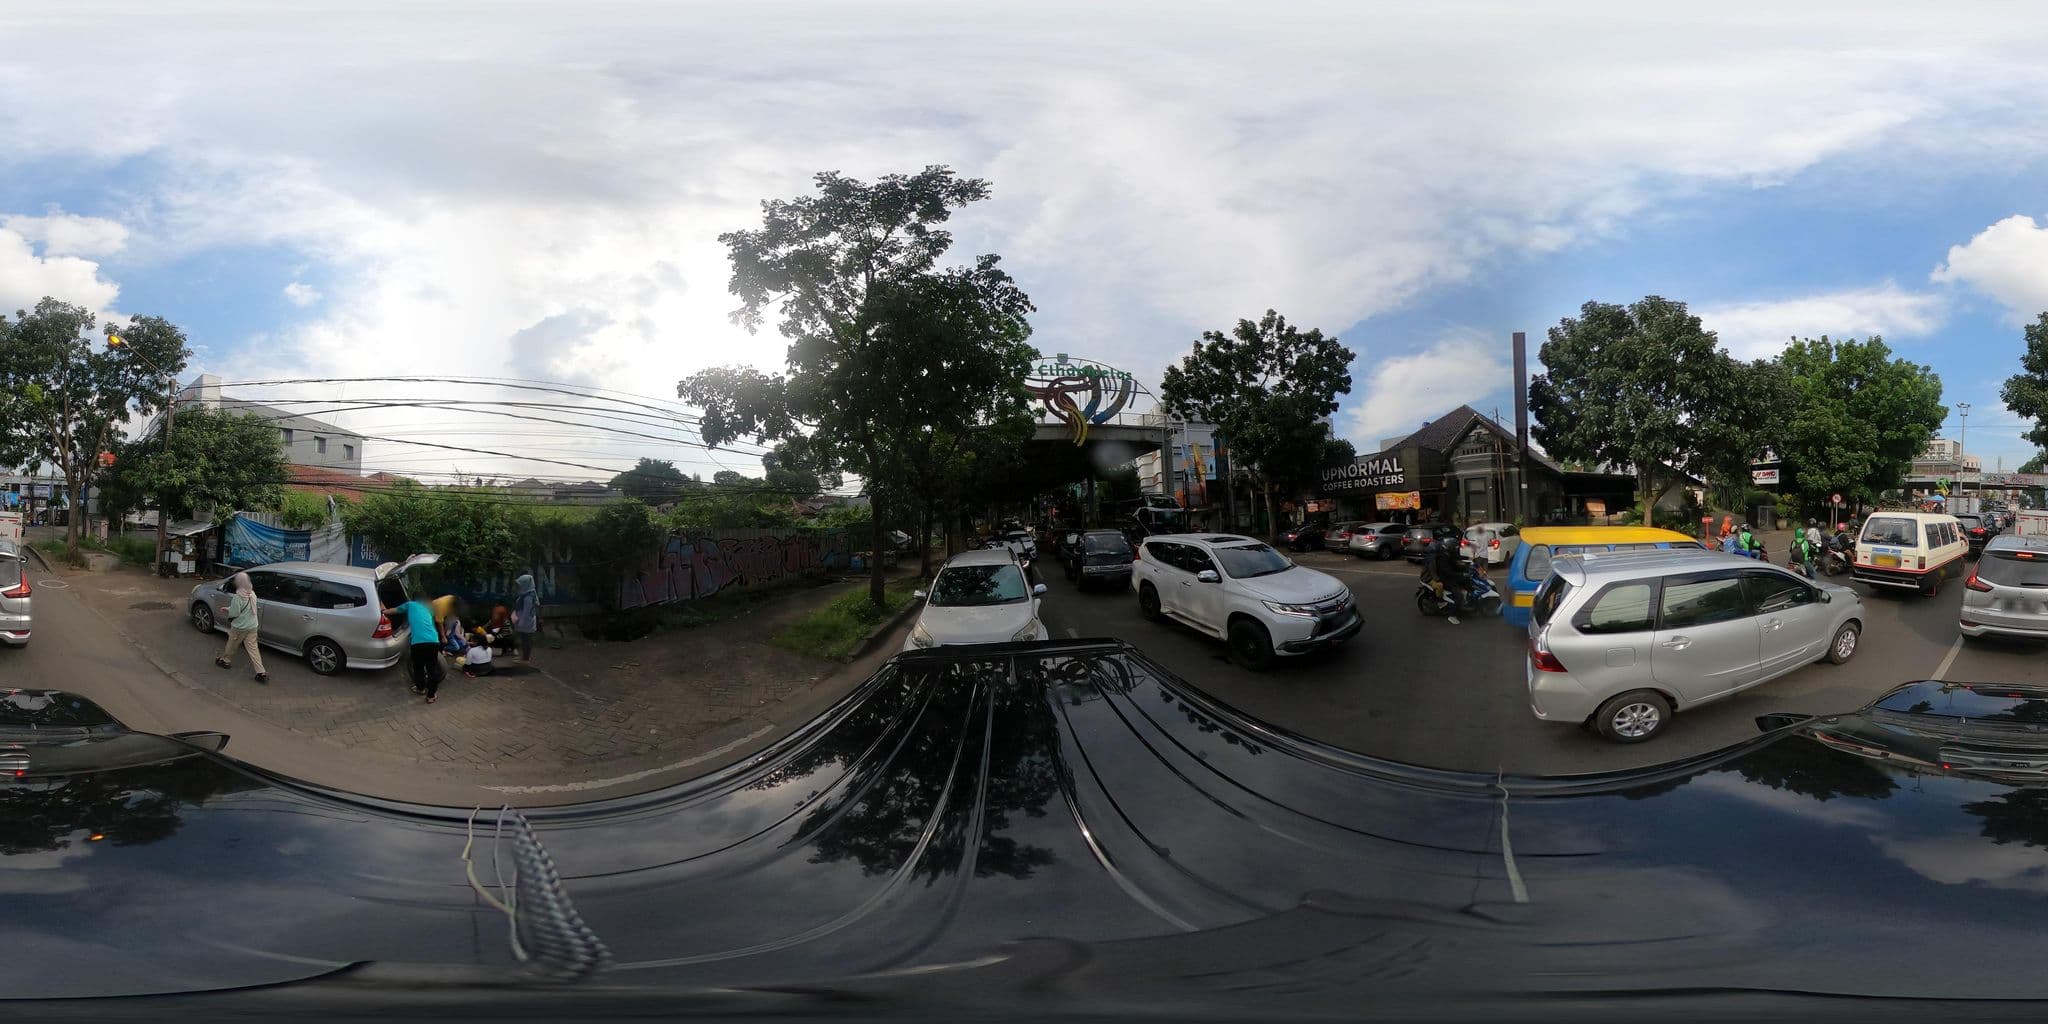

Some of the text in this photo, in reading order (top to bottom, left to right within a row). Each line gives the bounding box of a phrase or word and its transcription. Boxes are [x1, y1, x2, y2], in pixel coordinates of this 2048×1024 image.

[1322, 457, 1403, 481] UPNORMAL
[1323, 474, 1404, 491] COFFEE ROASTERS
